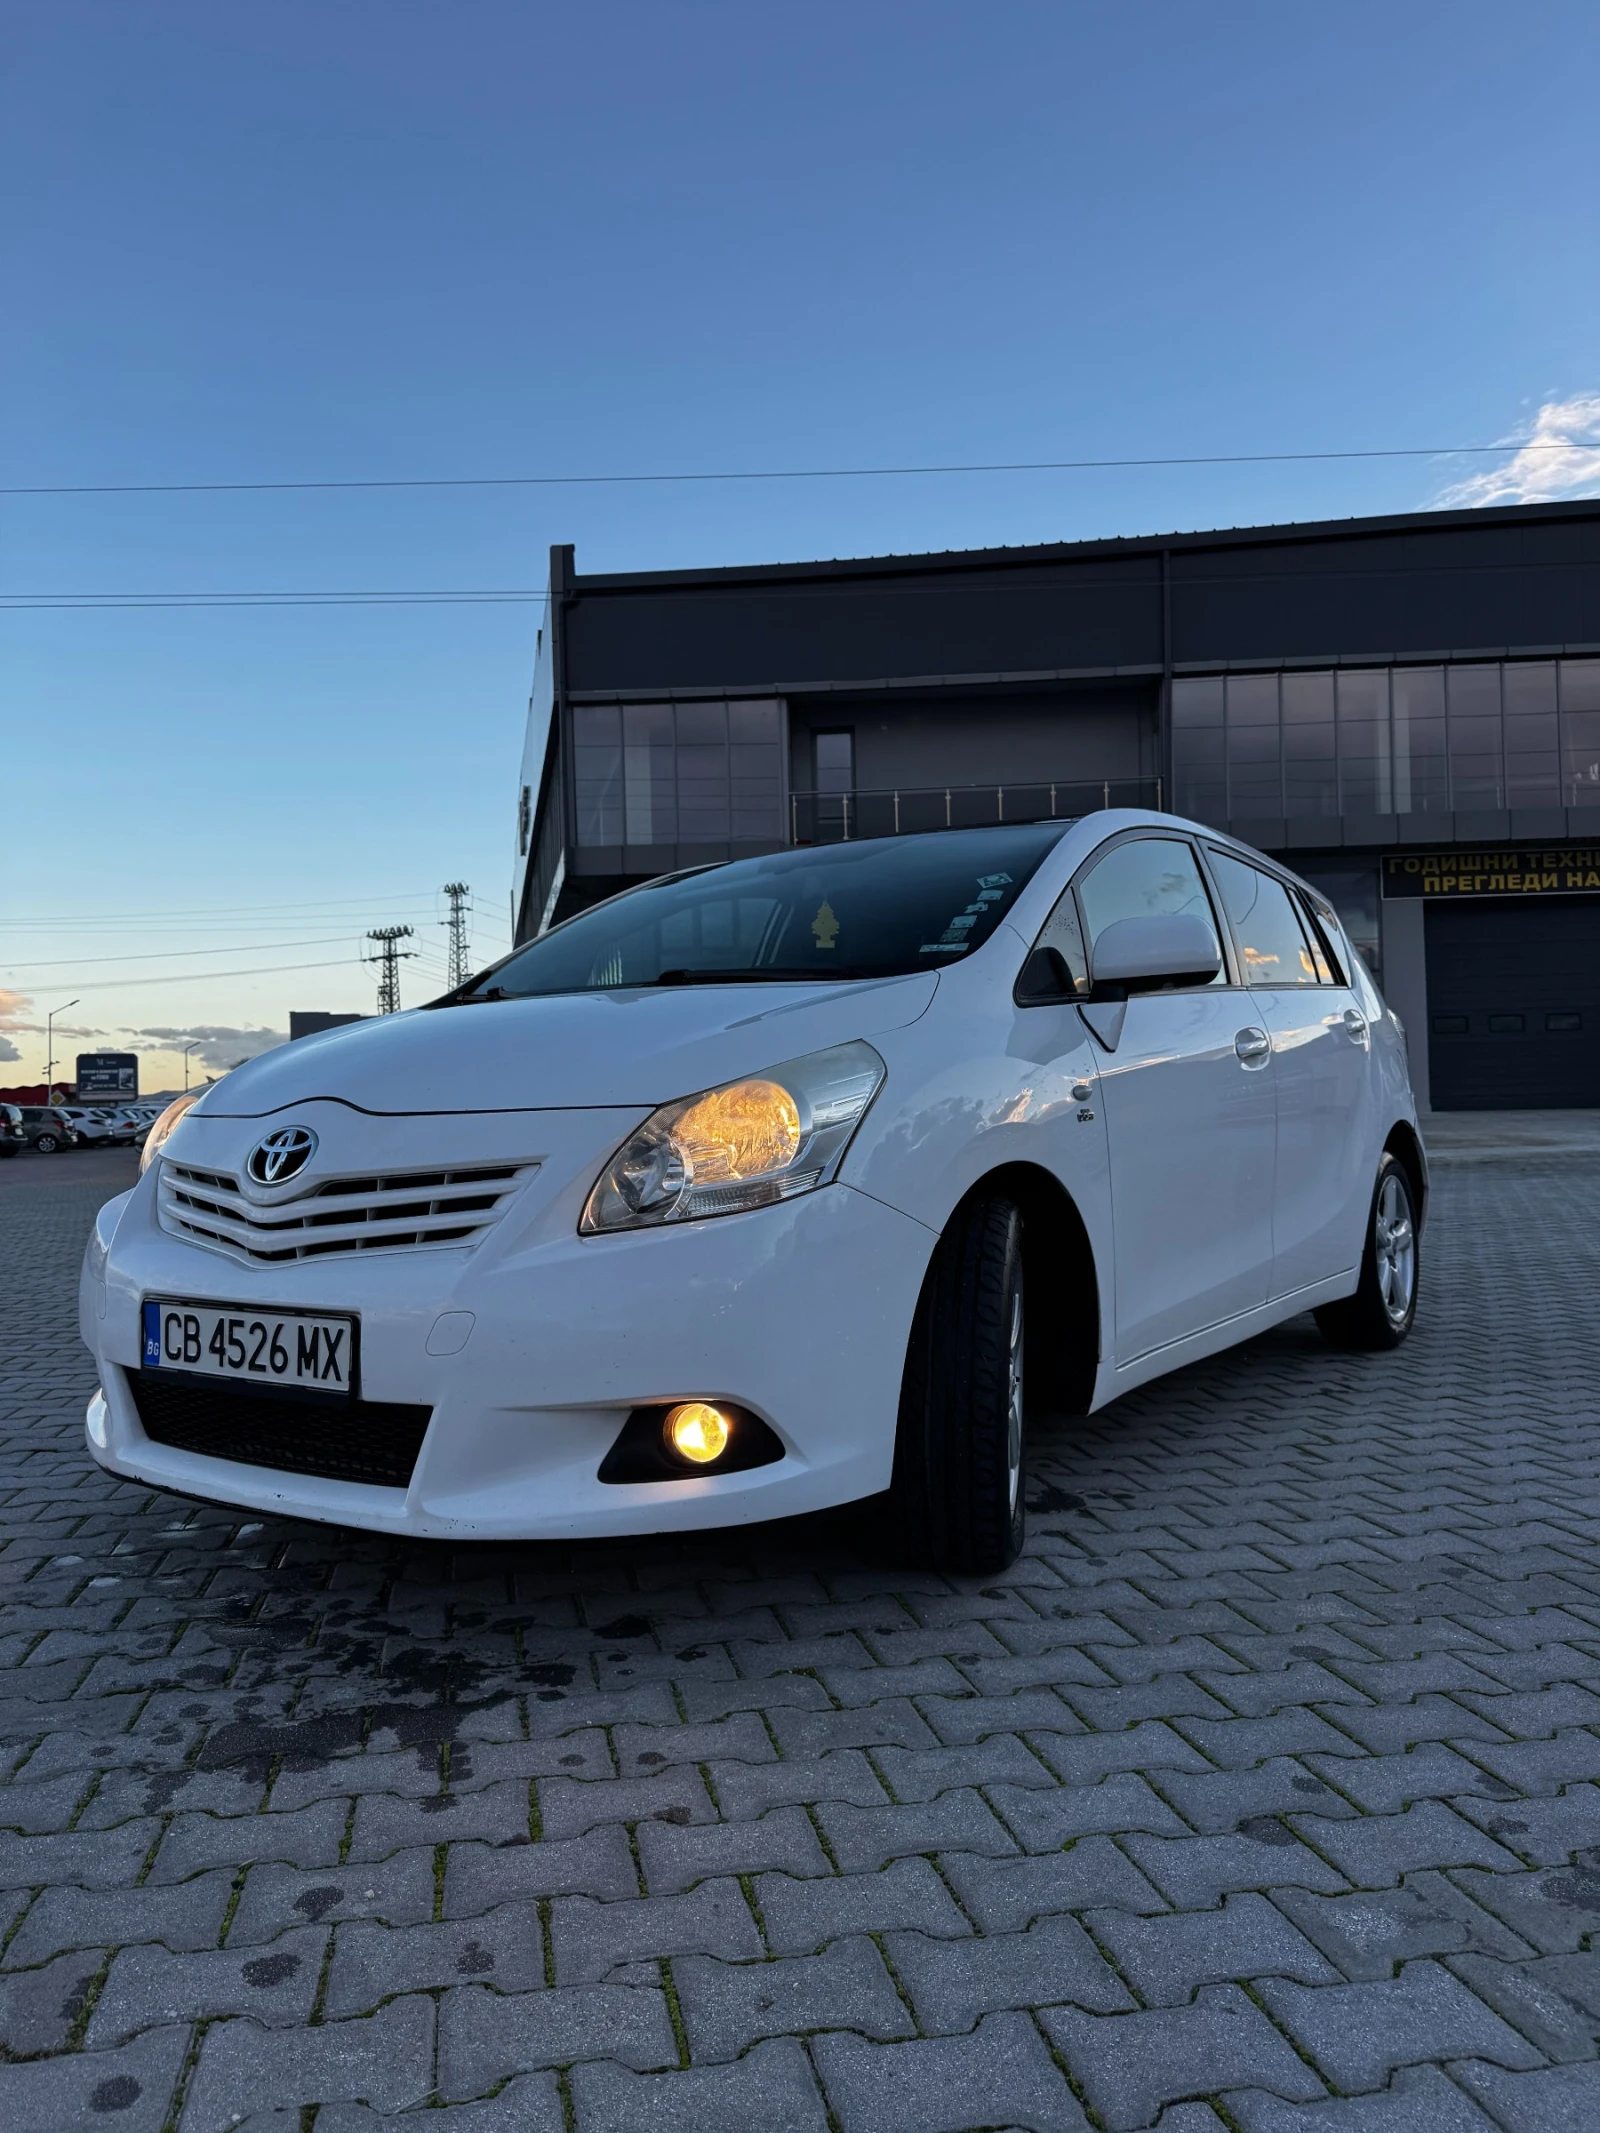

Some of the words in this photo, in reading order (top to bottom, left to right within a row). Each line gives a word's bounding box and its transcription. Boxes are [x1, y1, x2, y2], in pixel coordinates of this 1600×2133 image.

[1389, 854, 1518, 875] ГОДИШНИ
[1423, 872, 1558, 893] ПРЕГЛЕДИ
[1566, 871, 1600, 888] НА
[146, 1340, 160, 1356] BG
[164, 1312, 202, 1363] CB
[208, 1317, 289, 1374] 4526
[296, 1325, 345, 1382] MX
